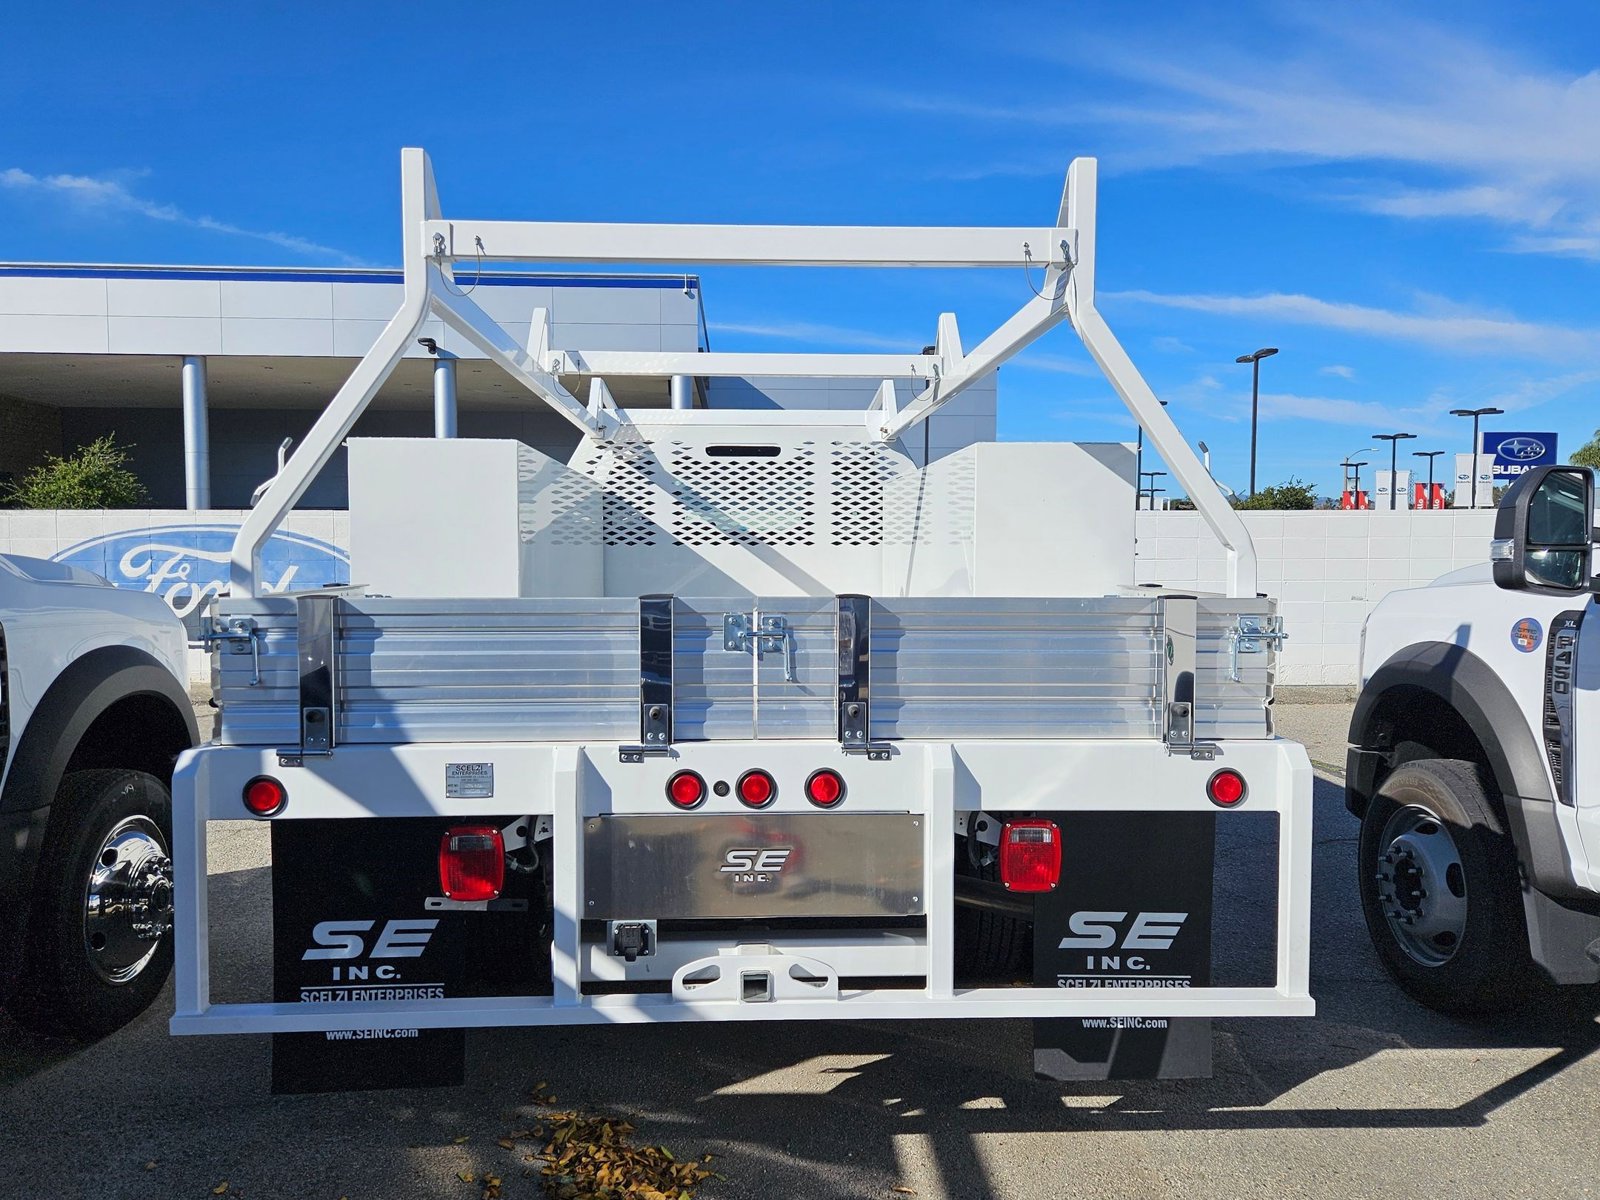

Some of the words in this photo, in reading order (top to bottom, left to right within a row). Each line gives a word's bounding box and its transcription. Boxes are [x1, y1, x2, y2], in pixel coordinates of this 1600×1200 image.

[1564, 620, 1576, 628] XL
[1553, 635, 1573, 695] F450
[720, 849, 791, 872] SE
[1058, 911, 1189, 950] SE
[301, 919, 440, 960] SE
[1086, 955, 1151, 971] INC.
[332, 965, 402, 981] INC.
[300, 990, 349, 1003] SCELZI
[352, 987, 444, 1002] ENTERPRISES
[1082, 1016, 1168, 1029] www.SEINC.com
[326, 1028, 419, 1040] www.SEINC.com
